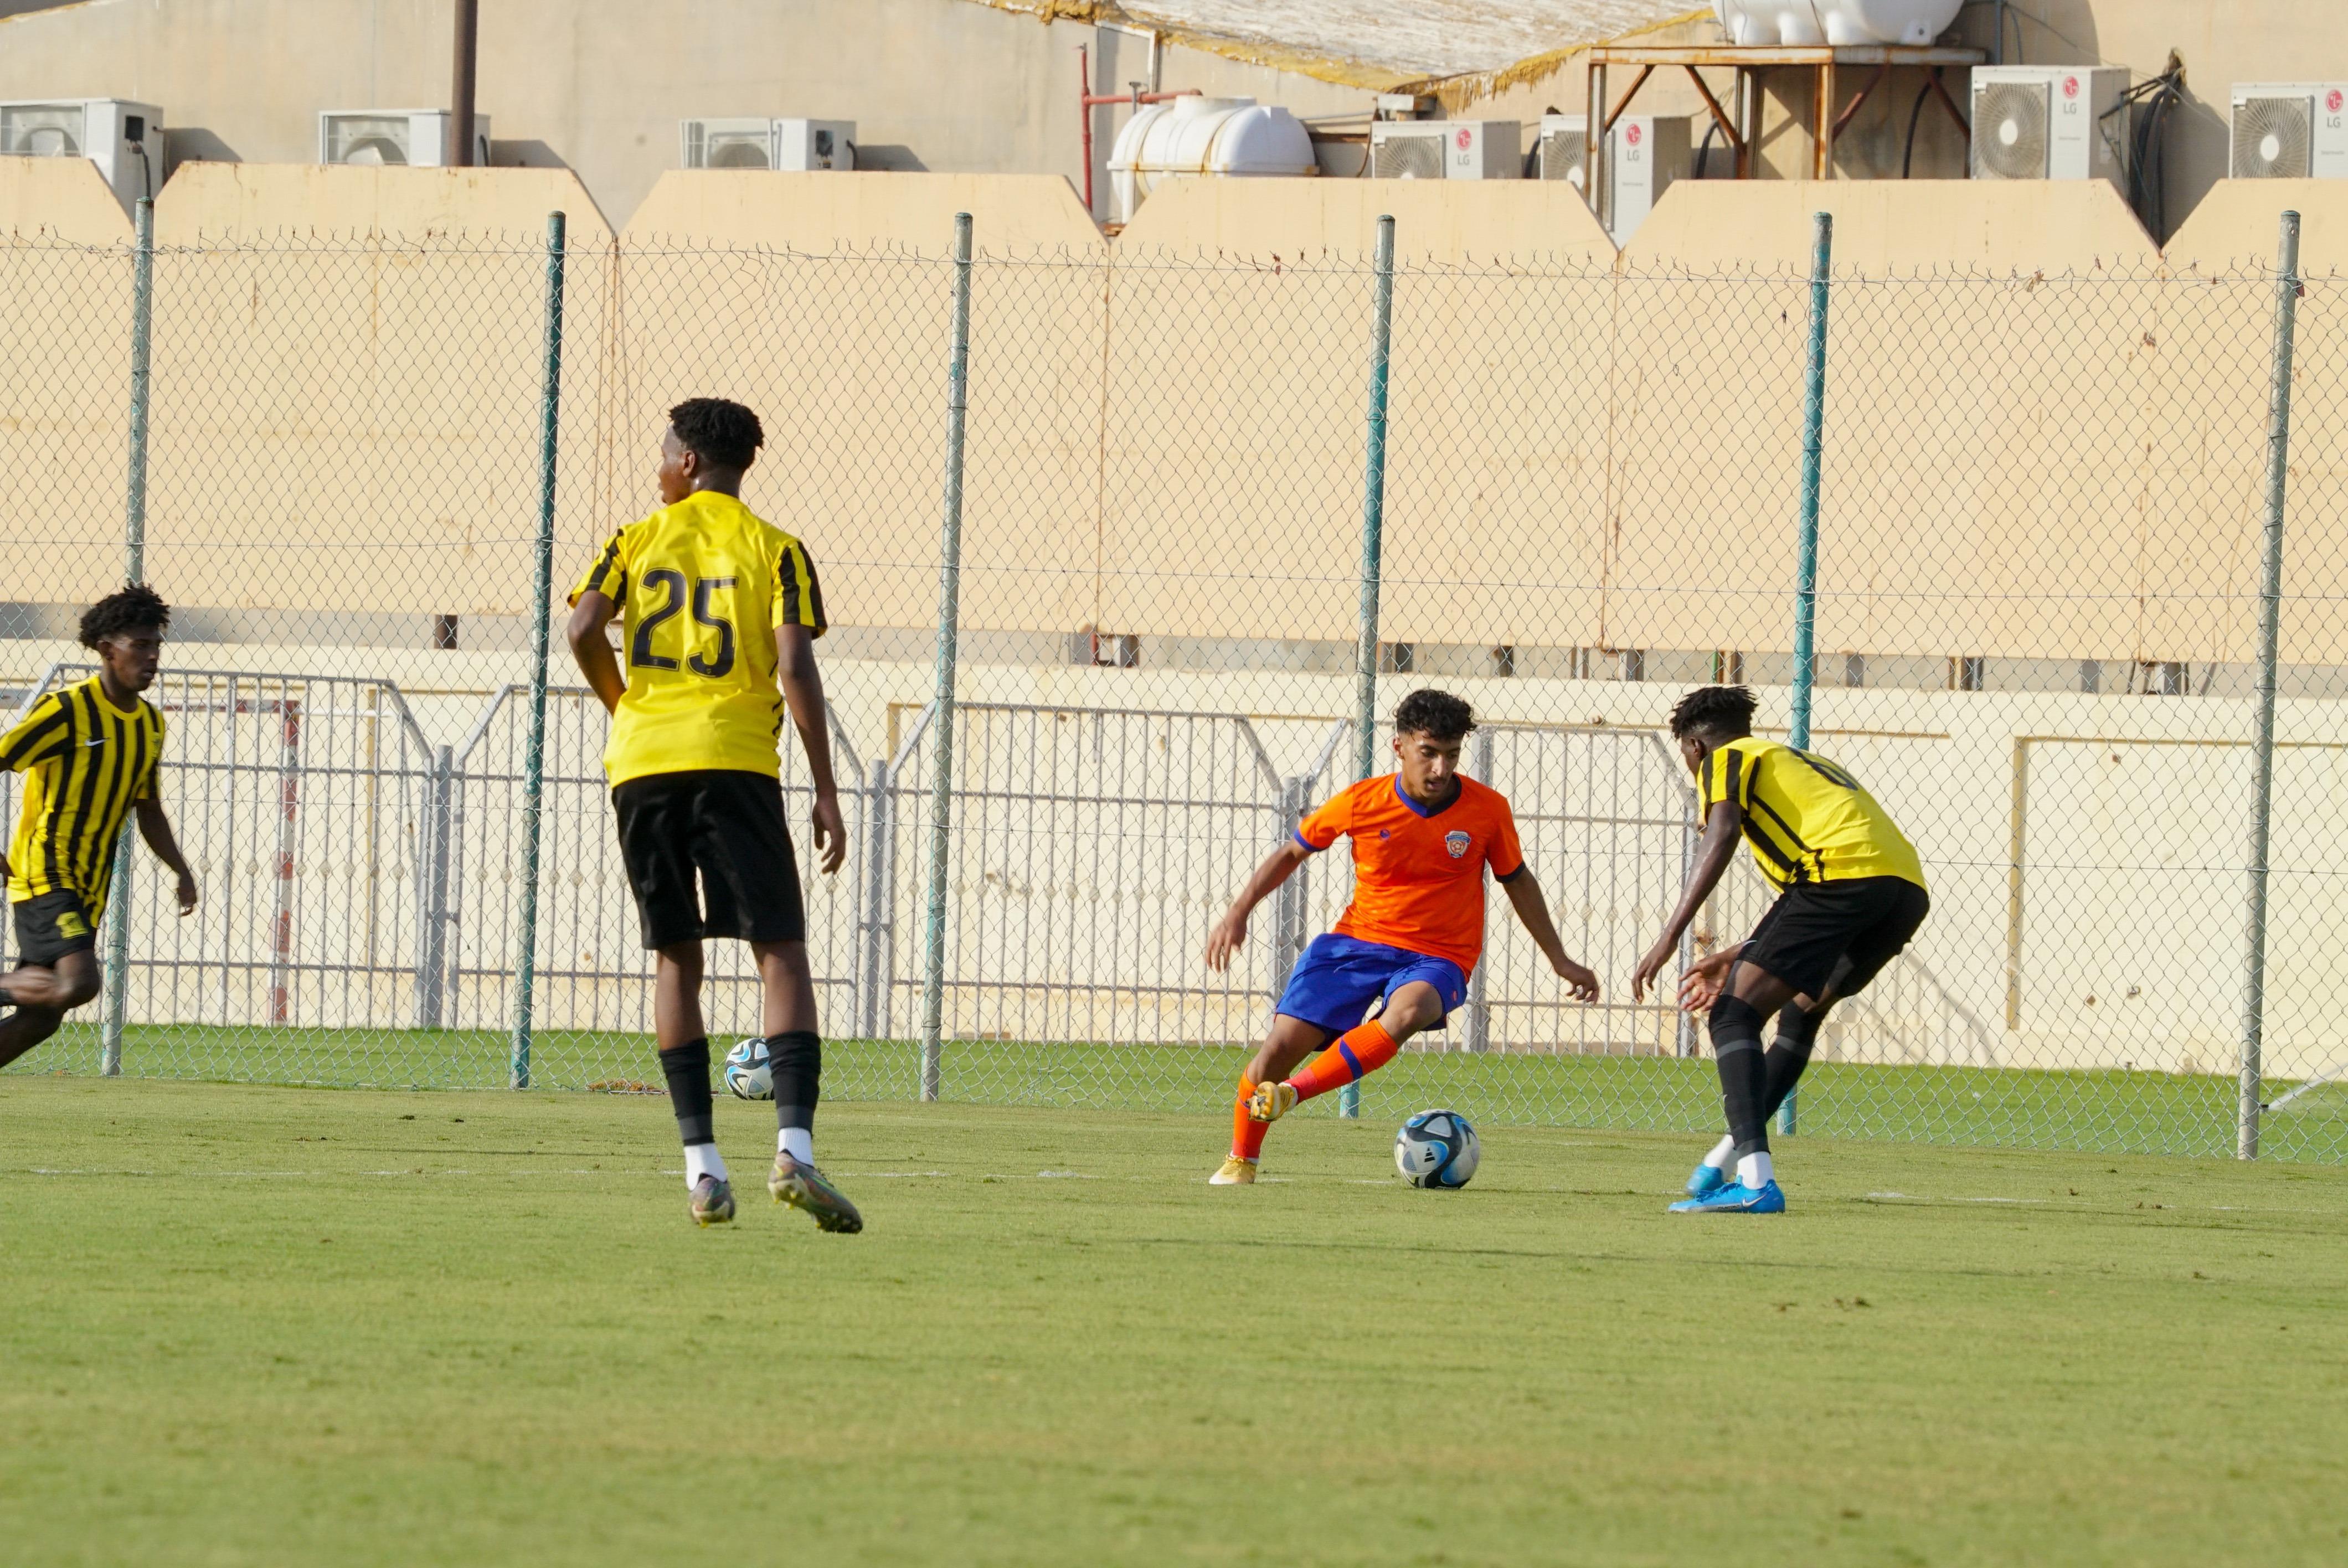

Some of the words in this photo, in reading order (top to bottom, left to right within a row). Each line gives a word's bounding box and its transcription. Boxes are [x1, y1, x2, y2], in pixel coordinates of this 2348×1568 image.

[2063, 102, 2077, 114] LG
[2327, 116, 2341, 128] LG
[1458, 154, 1470, 166] LG
[1627, 149, 1639, 161] LG
[631, 567, 739, 678] 25
